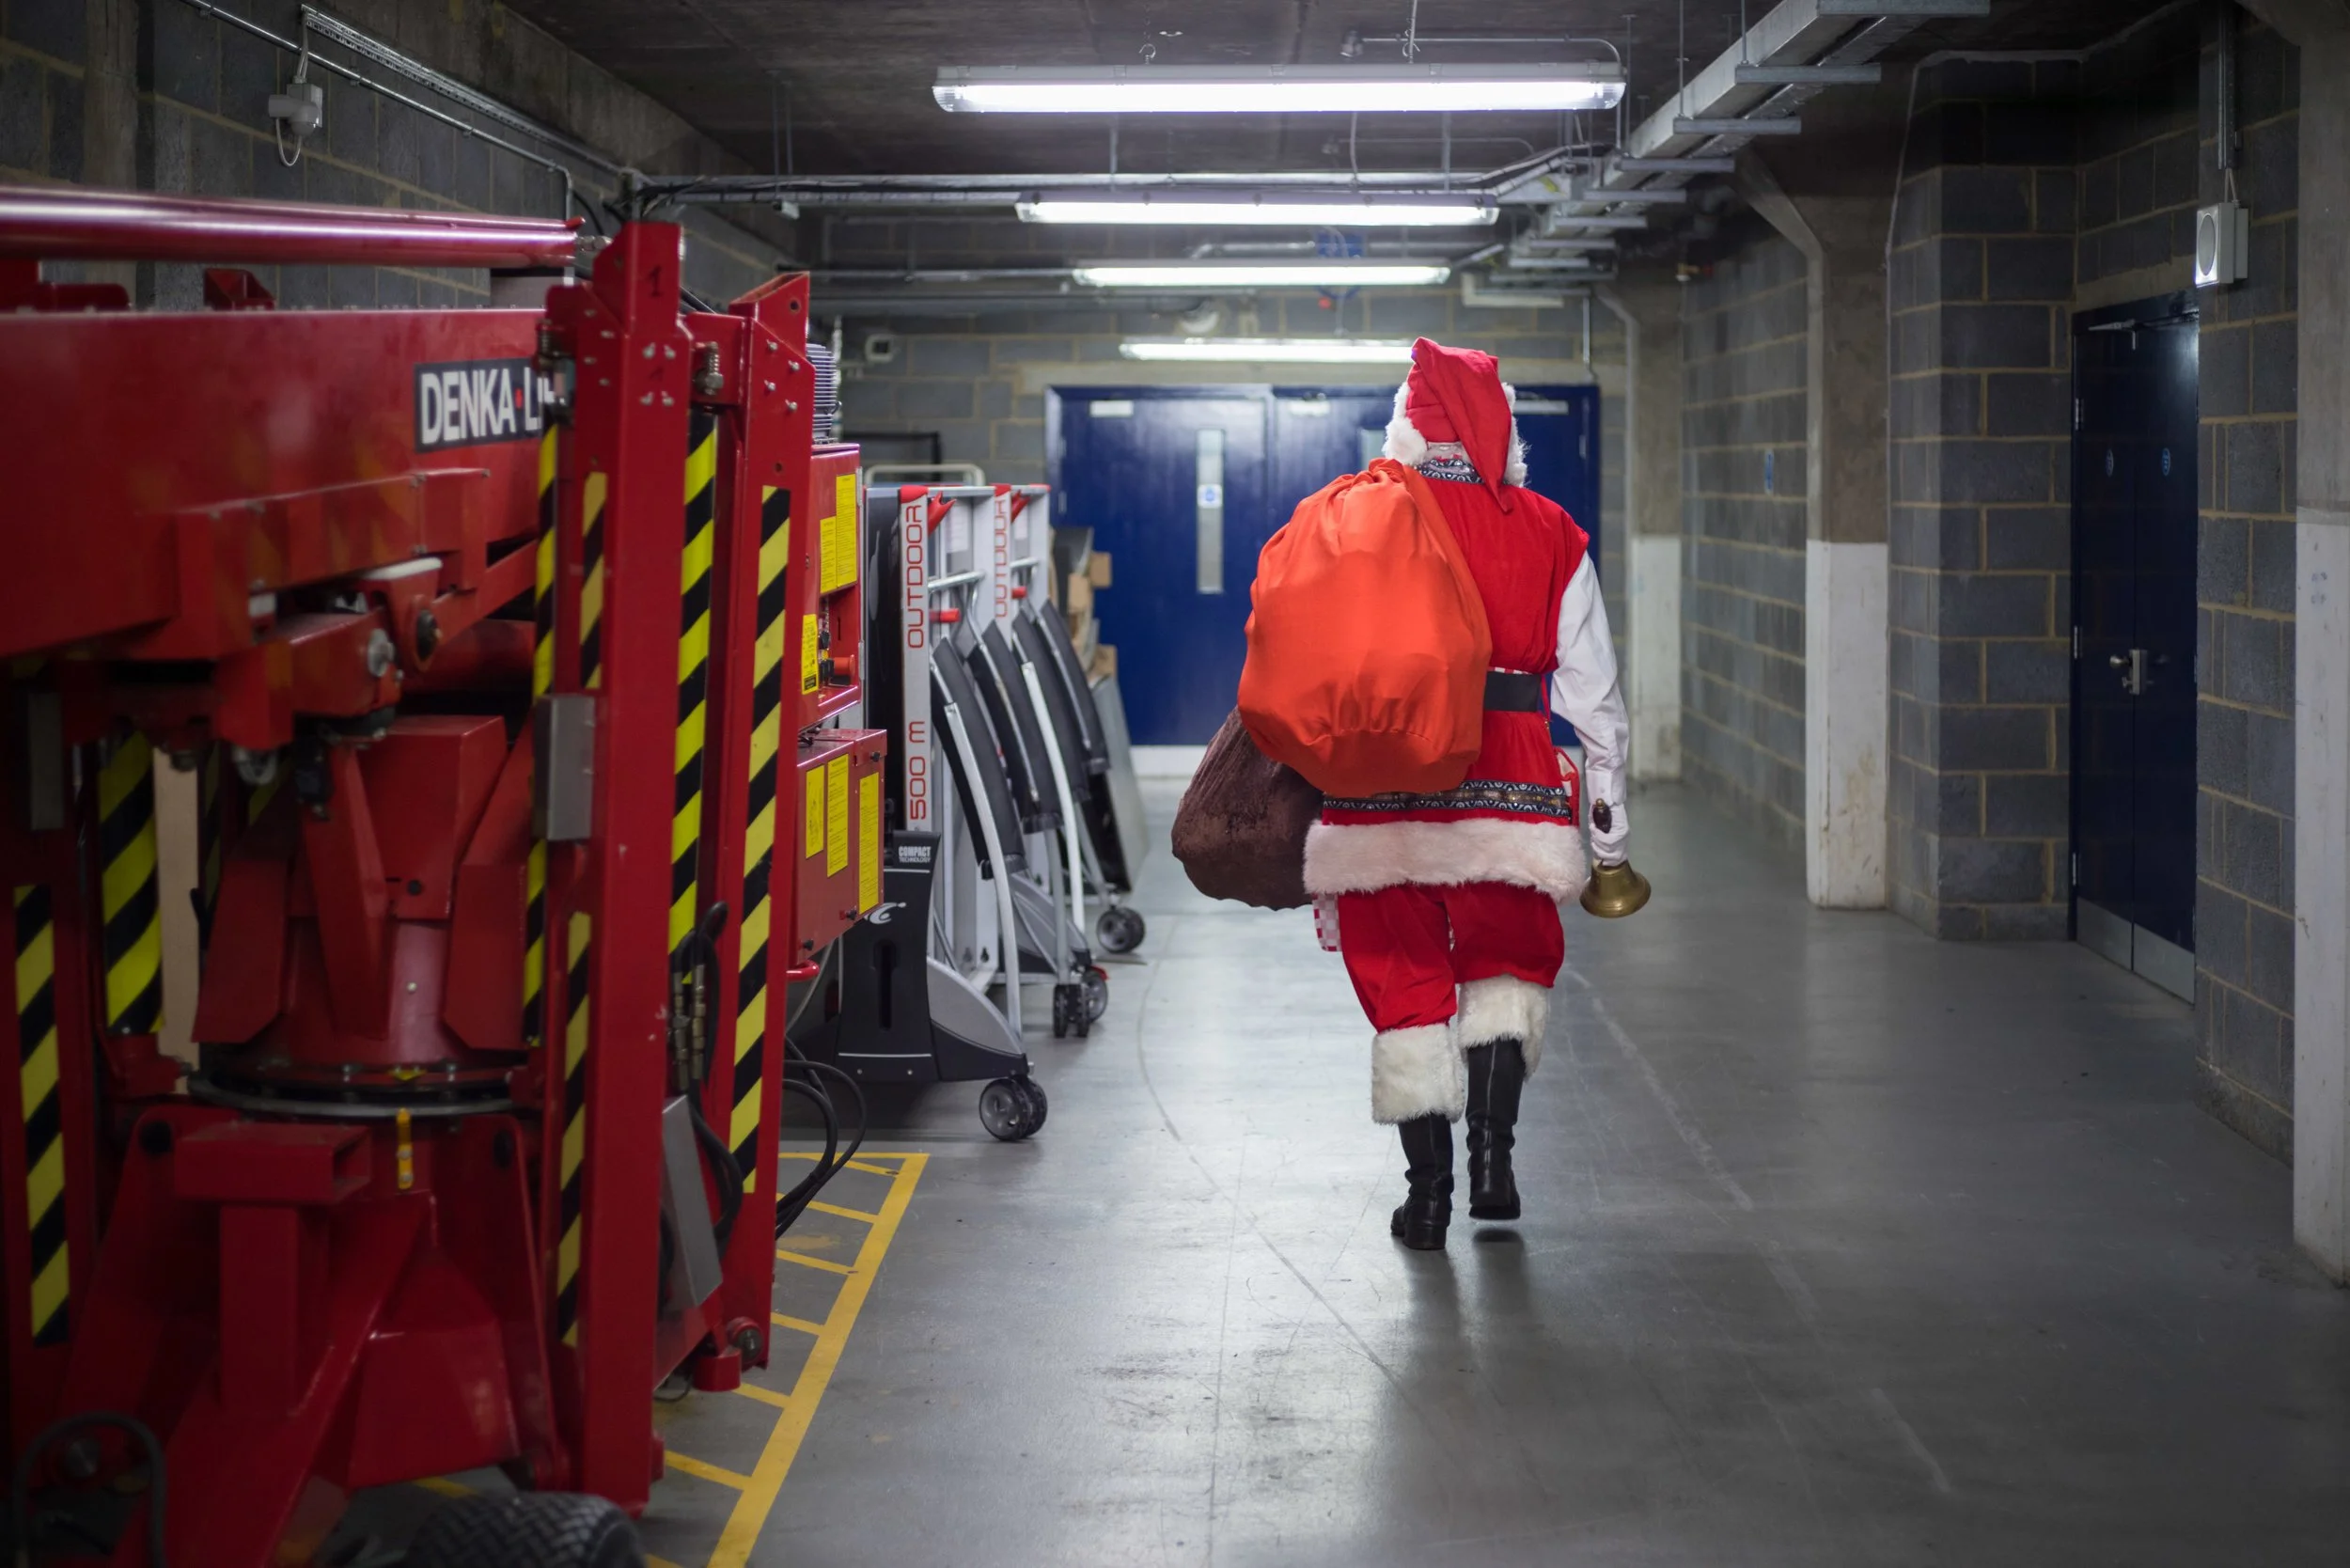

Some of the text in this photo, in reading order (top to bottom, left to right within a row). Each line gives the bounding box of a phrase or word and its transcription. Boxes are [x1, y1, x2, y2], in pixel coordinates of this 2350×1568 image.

[905, 505, 924, 649] OUTDOOR
[909, 756, 926, 820] 500
[899, 846, 932, 856] COMPACT
